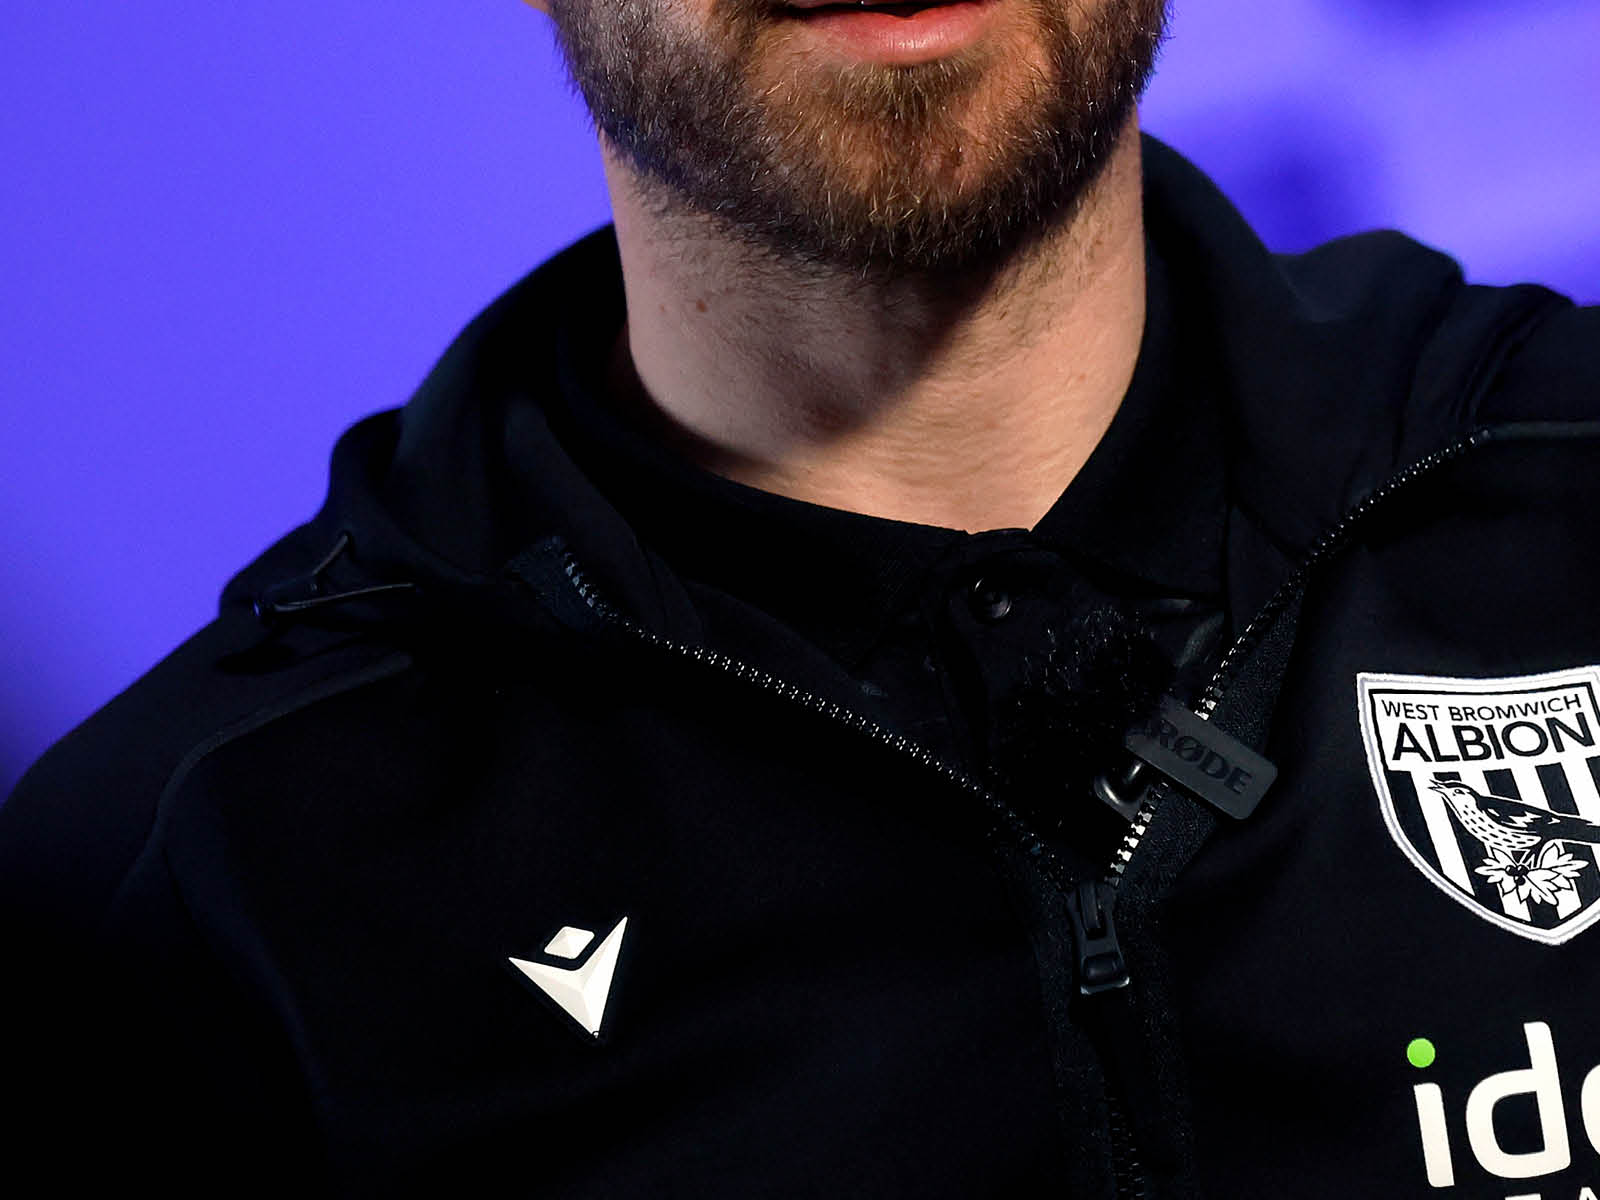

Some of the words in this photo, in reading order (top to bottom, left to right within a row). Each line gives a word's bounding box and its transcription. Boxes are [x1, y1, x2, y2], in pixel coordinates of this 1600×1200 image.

[1381, 699, 1439, 720] WEST
[1449, 693, 1582, 721] BROMWICH
[1392, 712, 1595, 762] ALBION
